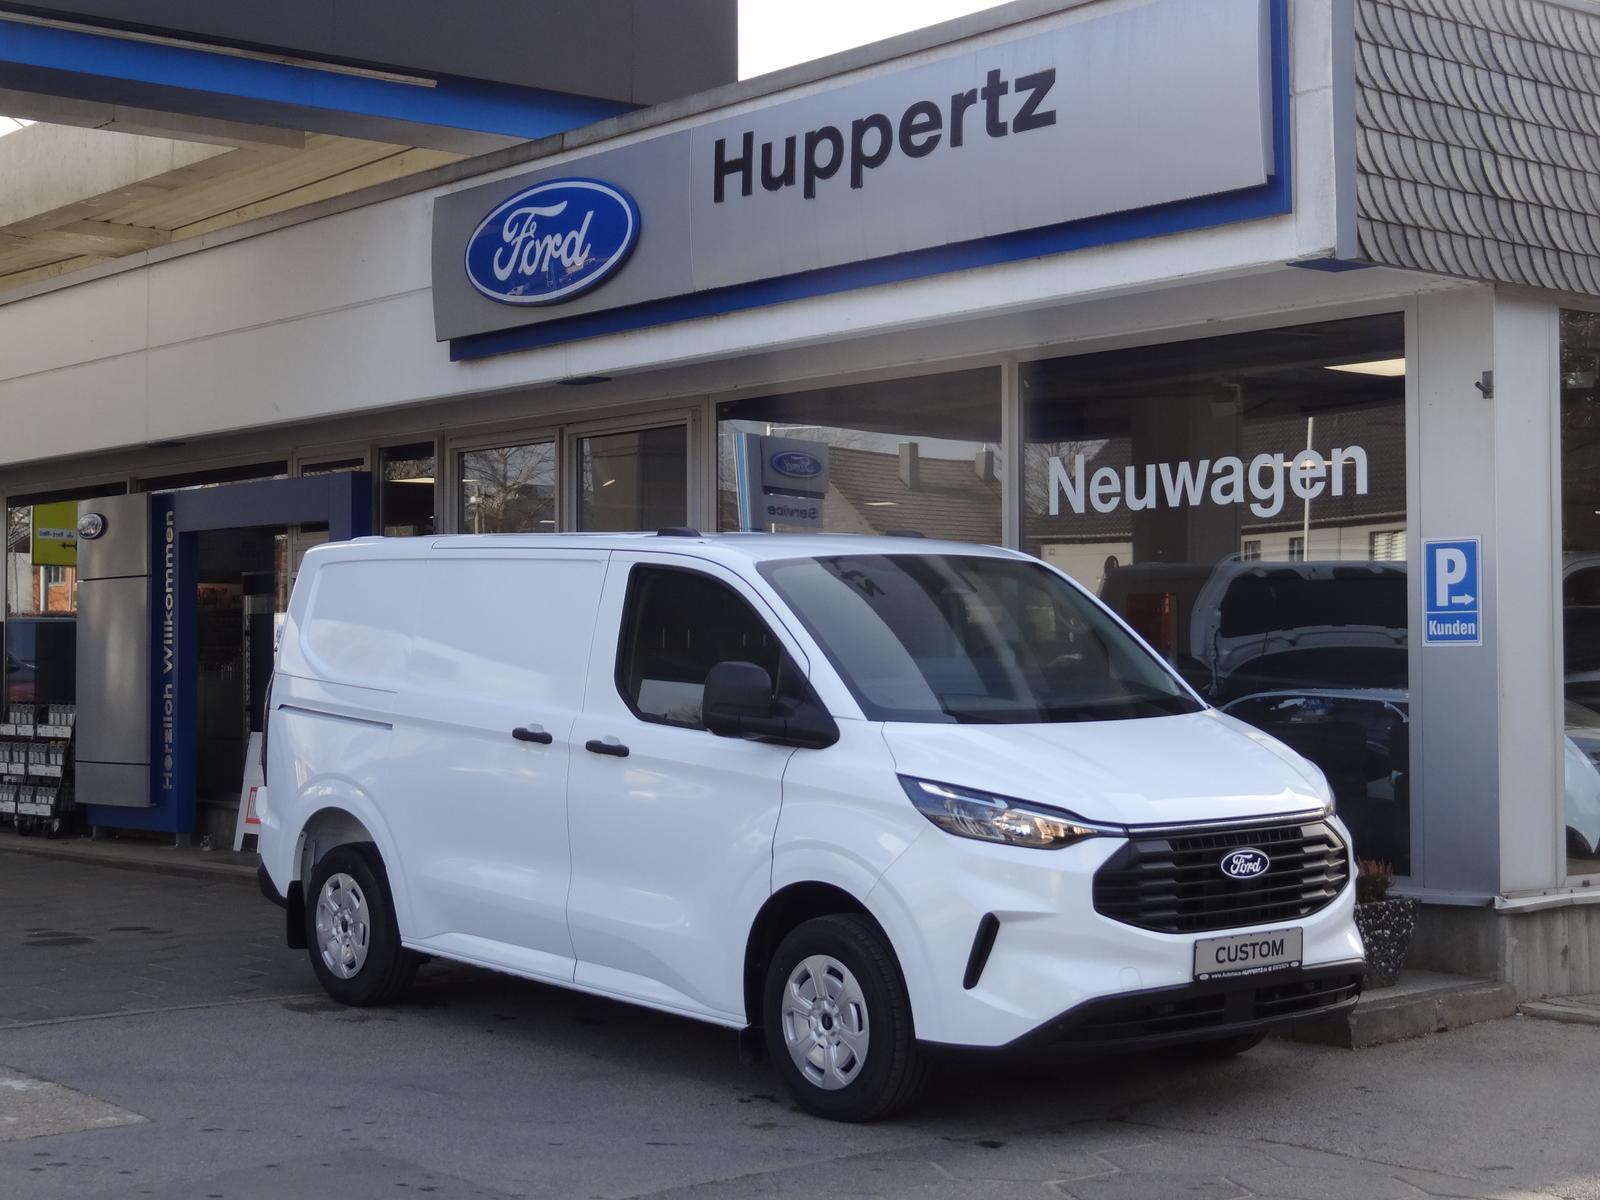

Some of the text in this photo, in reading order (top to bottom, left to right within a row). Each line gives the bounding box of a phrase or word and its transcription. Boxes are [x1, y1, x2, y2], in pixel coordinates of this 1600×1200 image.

[713, 67, 1057, 203] Huppertz
[493, 200, 594, 281] Ford
[1048, 443, 1369, 518] Neuwagen
[163, 510, 174, 675] Willkommen
[1435, 547, 1467, 606] P
[1428, 620, 1476, 635] Kunden
[1230, 853, 1261, 874] Ford
[1215, 938, 1285, 964] CUSTOM
